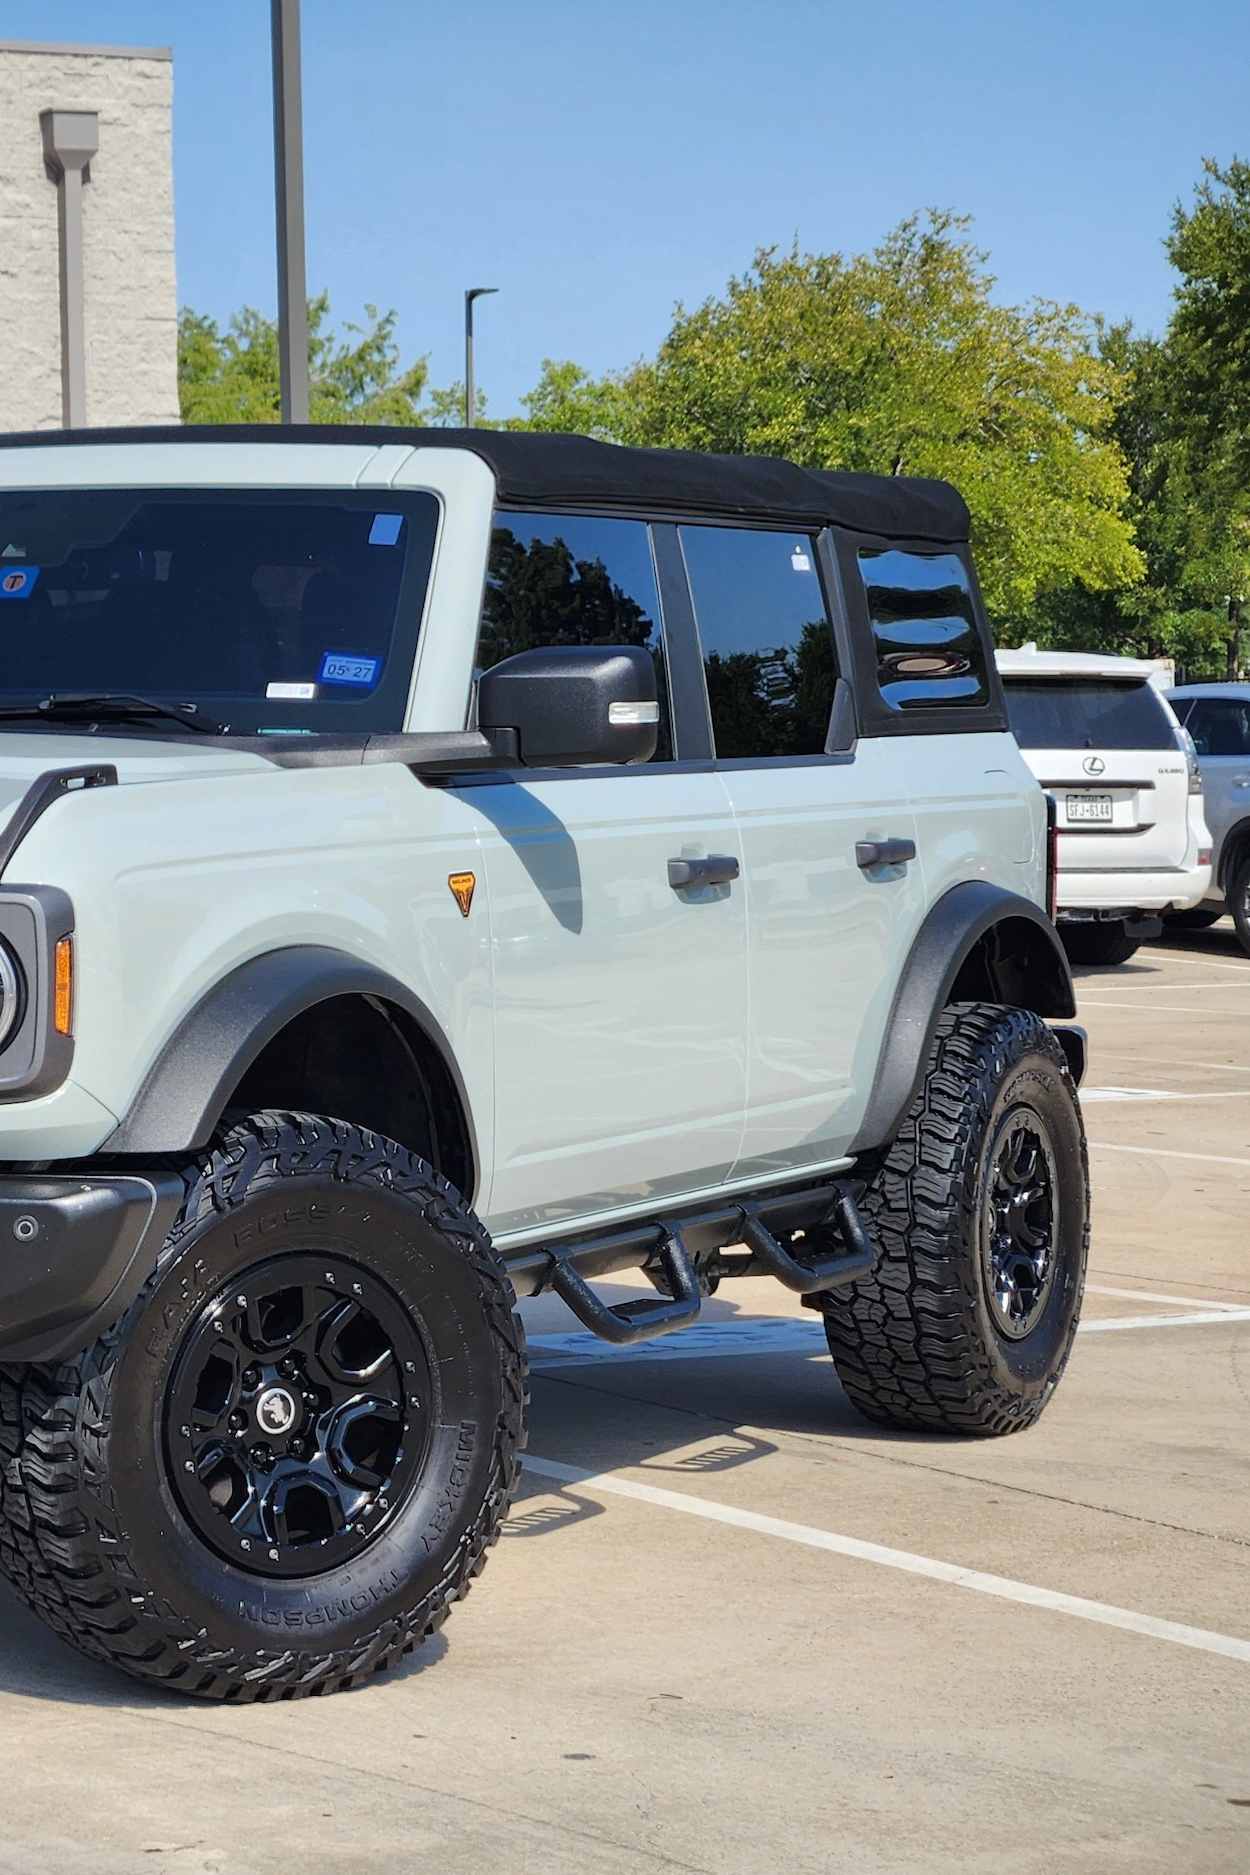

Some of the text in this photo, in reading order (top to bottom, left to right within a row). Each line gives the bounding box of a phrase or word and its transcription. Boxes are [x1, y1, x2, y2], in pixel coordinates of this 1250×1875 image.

[327, 664, 372, 678] 05 27
[238, 1420, 478, 1627] MICKEY THOMPSON
